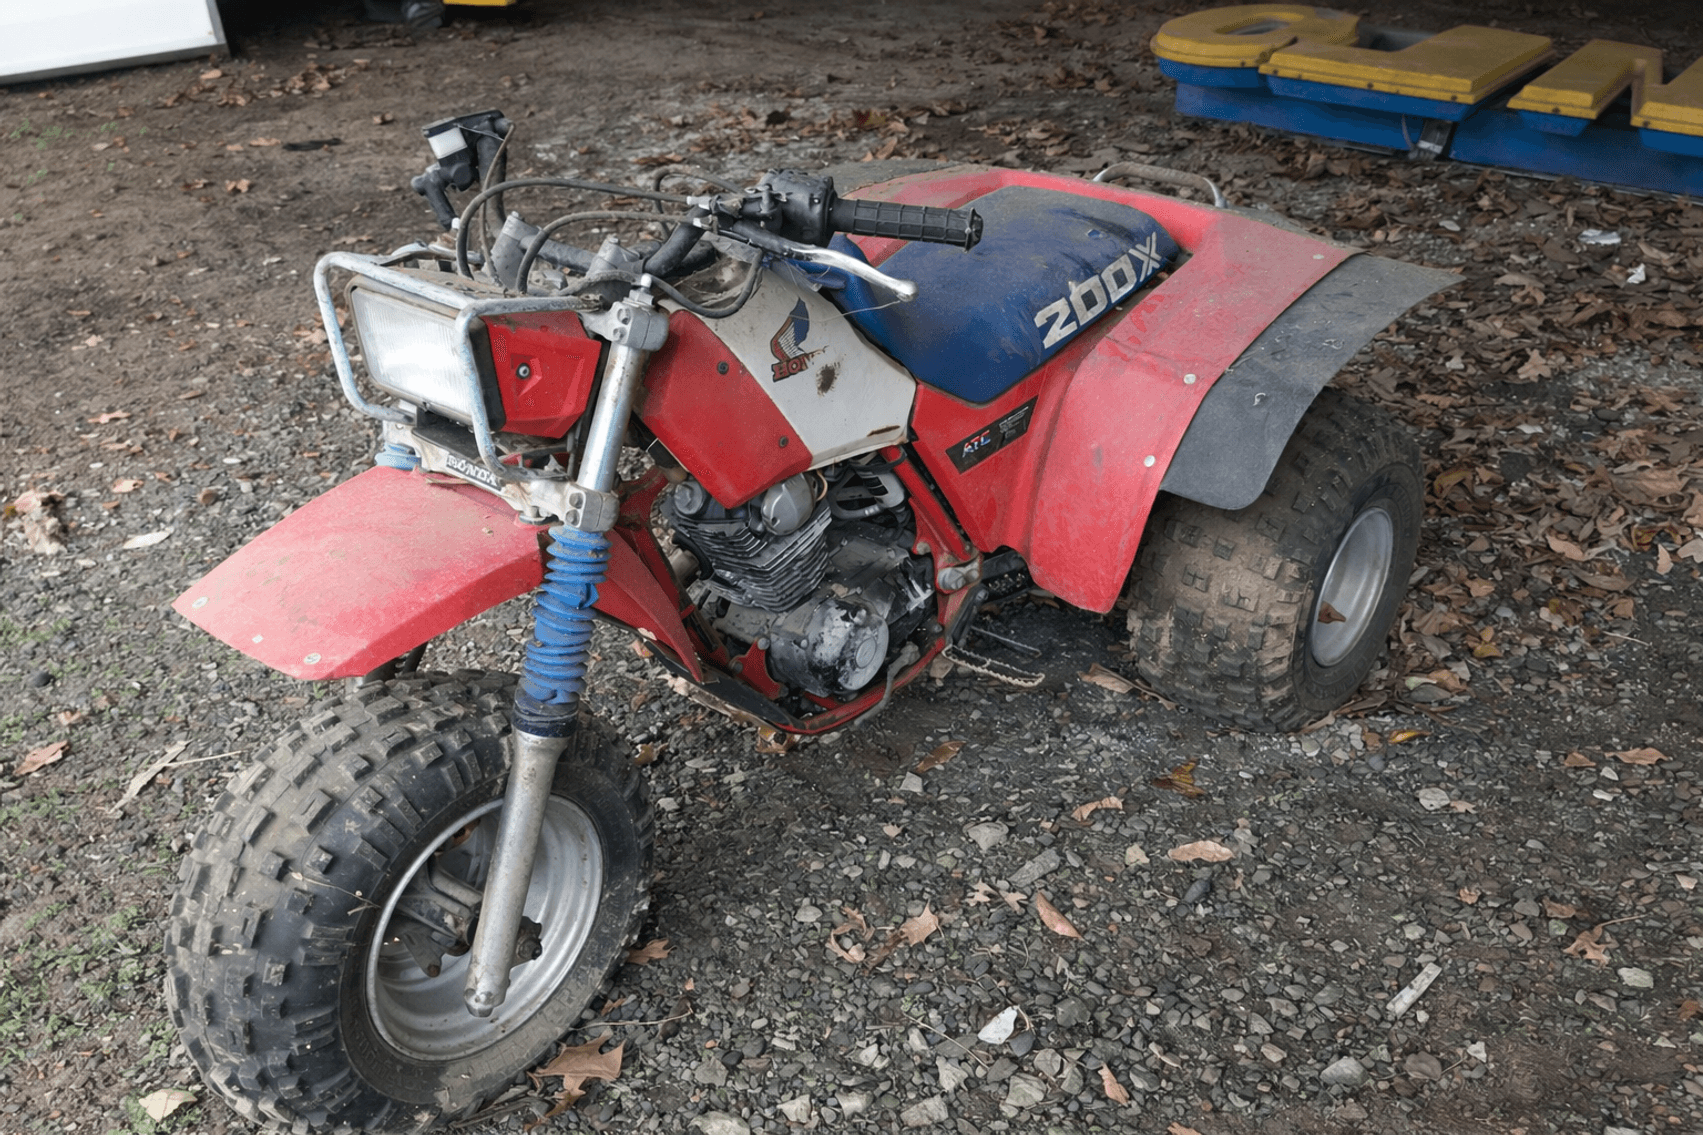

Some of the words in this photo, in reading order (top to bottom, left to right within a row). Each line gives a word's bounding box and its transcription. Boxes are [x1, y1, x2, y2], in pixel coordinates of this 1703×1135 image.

[1034, 232, 1162, 349] 200X
[962, 430, 991, 458] ATC
[447, 454, 498, 487] HONDA
